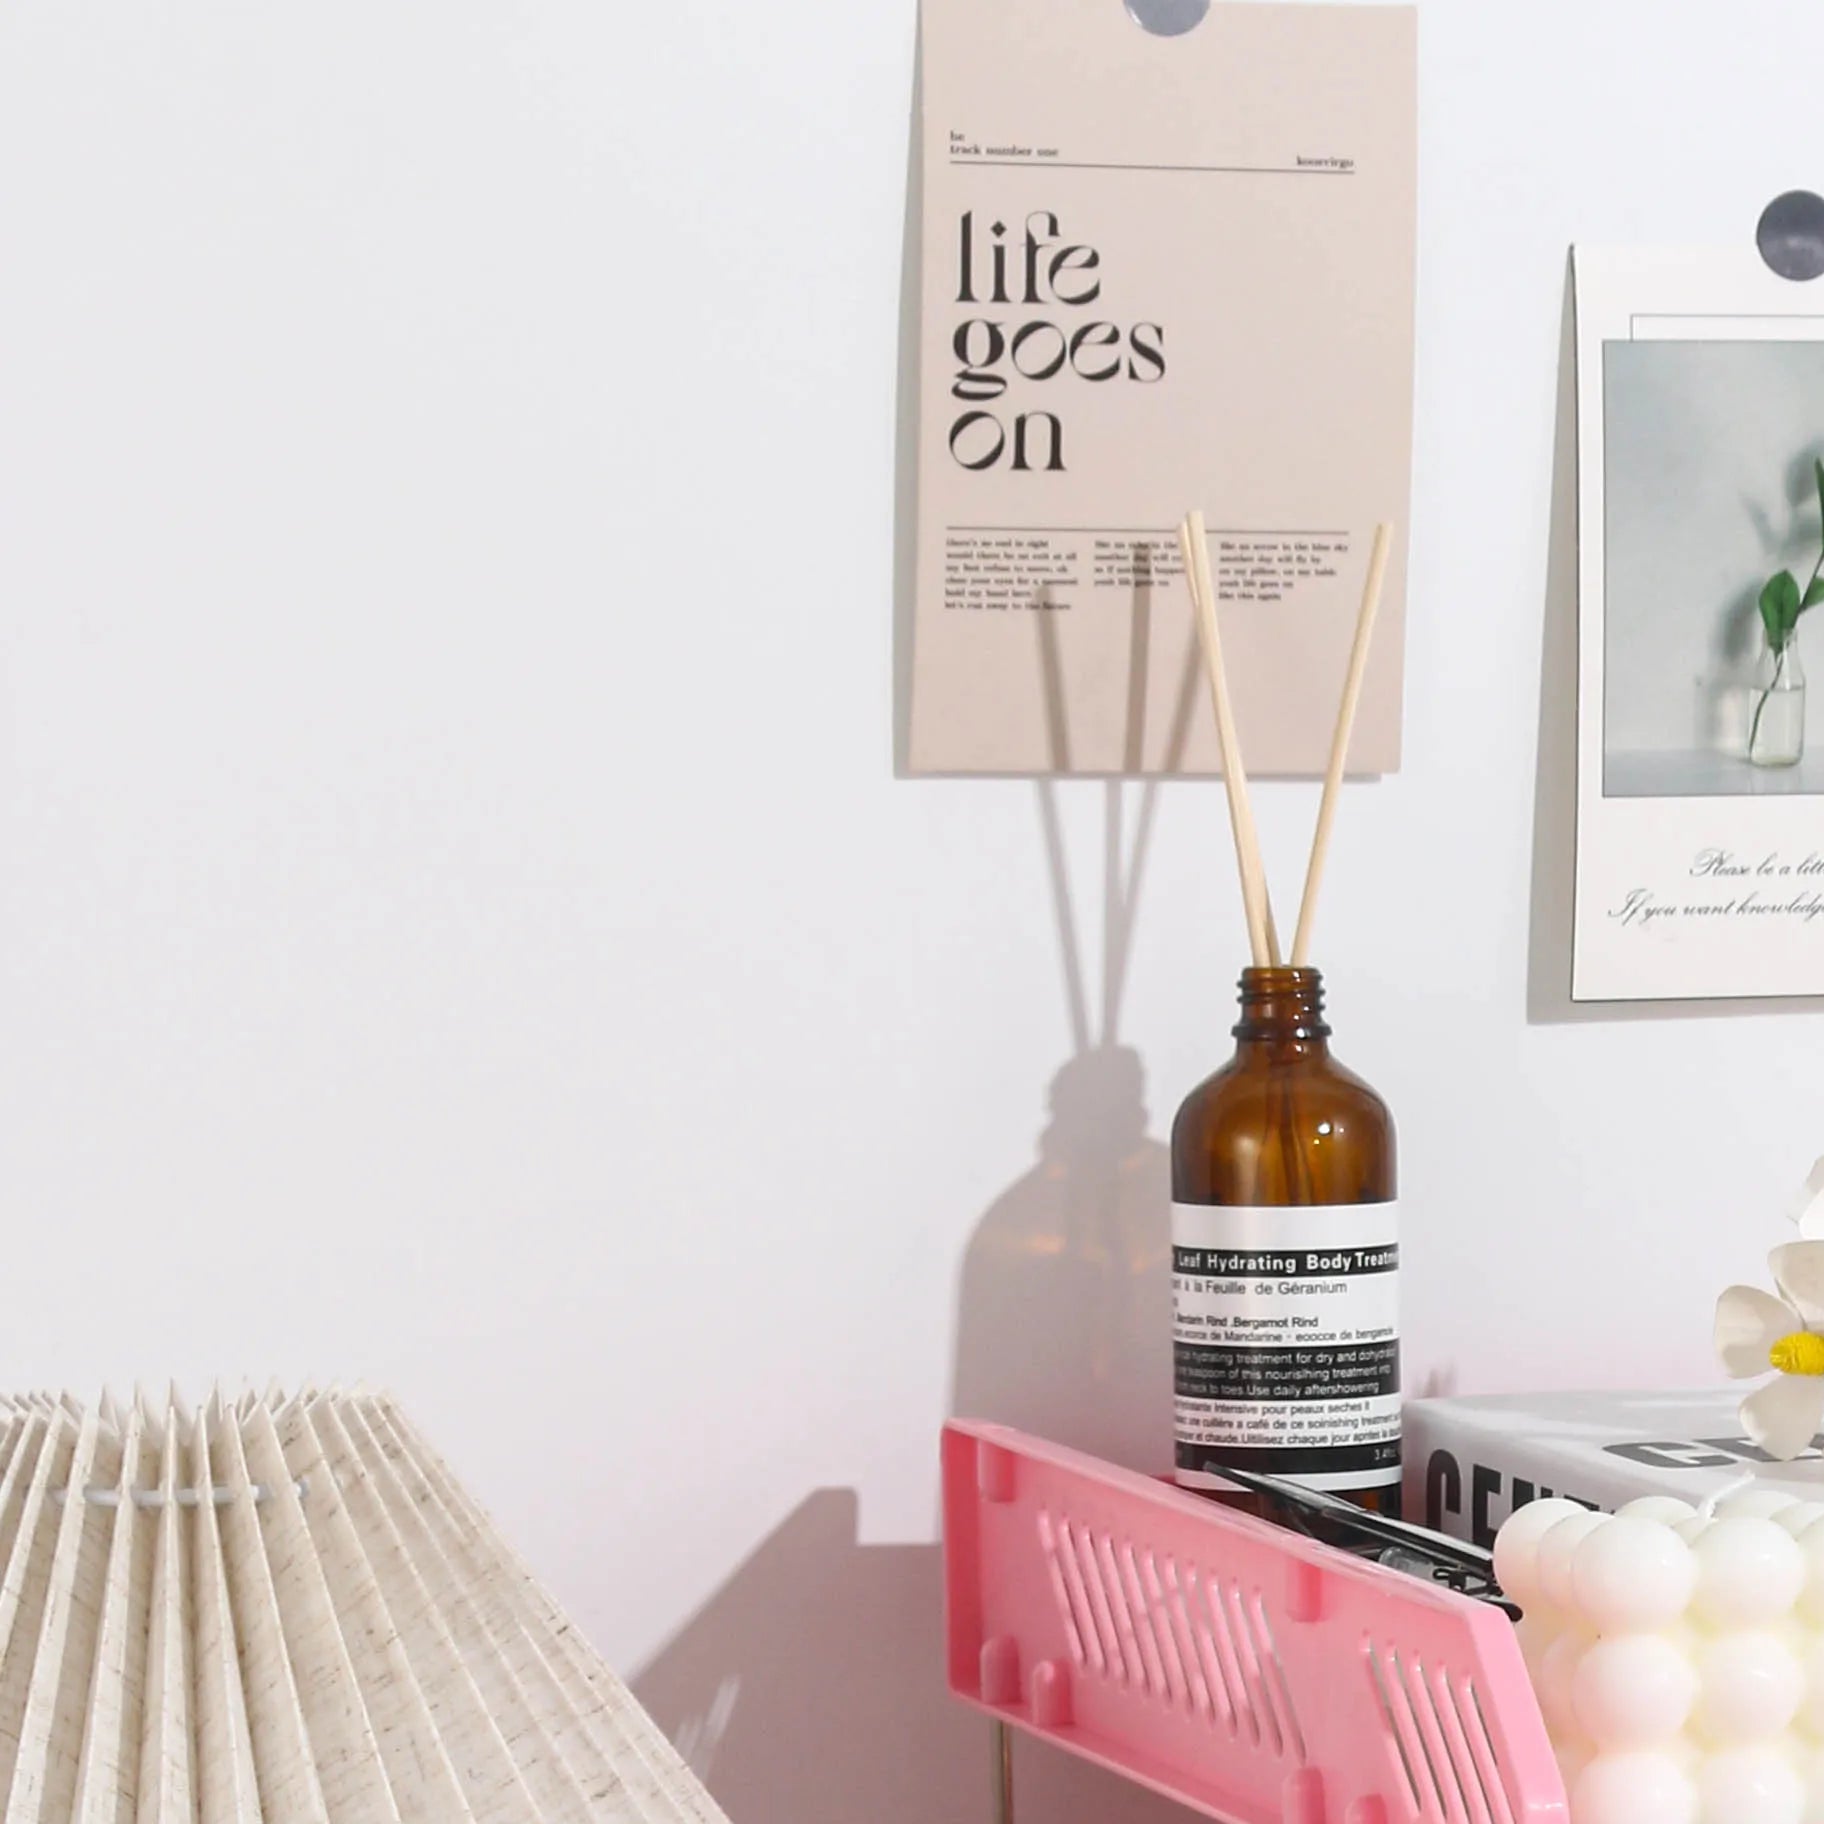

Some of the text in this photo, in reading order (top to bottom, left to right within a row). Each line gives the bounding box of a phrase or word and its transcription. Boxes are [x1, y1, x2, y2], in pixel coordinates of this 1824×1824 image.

[953, 210, 1102, 306] life
[950, 319, 1168, 402] goes
[947, 409, 1068, 473] on
[1689, 847, 1751, 878] Please
[1756, 852, 1776, 877] be
[1779, 864, 1791, 877] a
[1638, 902, 1677, 926] you
[1683, 896, 1735, 917] want
[1207, 1254, 1297, 1274] Hydrating
[1306, 1252, 1352, 1272] Body
[1206, 1280, 1246, 1294] Feuille
[1255, 1282, 1273, 1295] de
[1278, 1281, 1348, 1296] Géranium
[1291, 1316, 1319, 1328] Rind
[1236, 1353, 1293, 1364] treatment
[1296, 1352, 1313, 1364] for
[1315, 1351, 1334, 1366] dry
[1337, 1350, 1357, 1363] and
[1262, 1405, 1287, 1417] pour
[1290, 1405, 1324, 1417] peaux
[1272, 1418, 1287, 1430] de
[1290, 1420, 1304, 1430] ce
[1286, 1434, 1329, 1446] chaque
